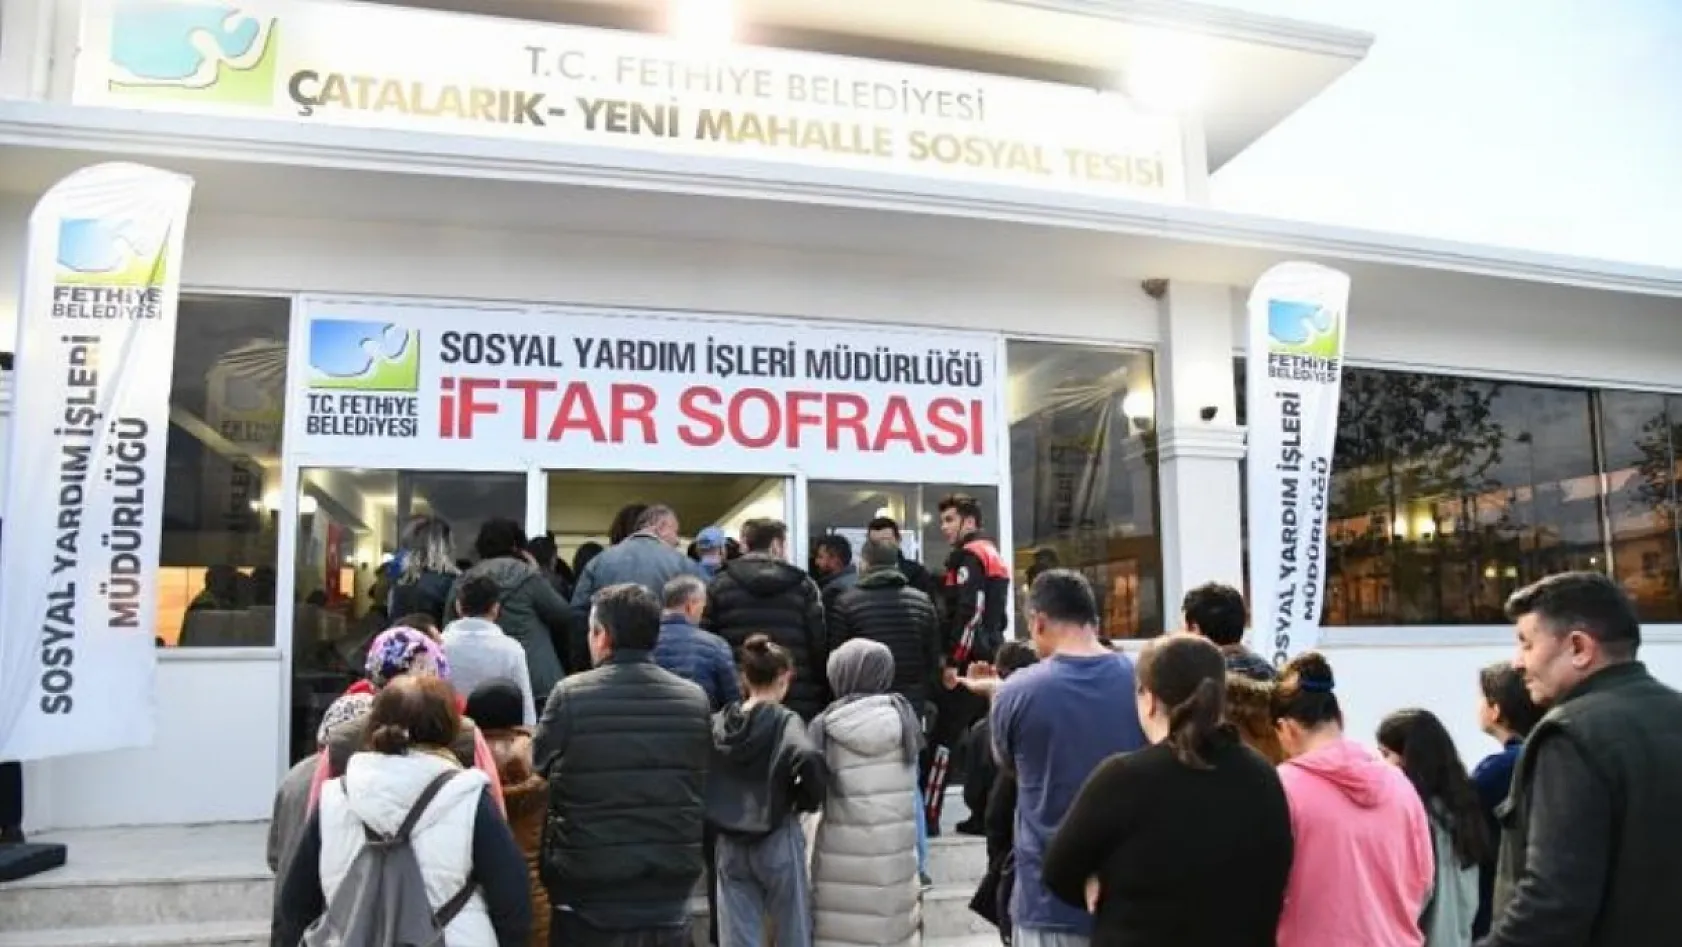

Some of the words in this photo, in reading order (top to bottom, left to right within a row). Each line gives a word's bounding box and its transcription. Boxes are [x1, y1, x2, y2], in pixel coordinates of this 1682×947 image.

[523, 44, 598, 81] T.C.
[787, 73, 986, 121] BELEDİYESİ
[575, 94, 681, 139] YENİ
[694, 107, 894, 158] MAHALLE
[907, 128, 1054, 176] SOSYAL
[440, 330, 562, 368] SOSYAL
[573, 337, 696, 374] YARDIM
[705, 336, 797, 378] İŞLERİ
[805, 343, 983, 388] MÜDÜRLÜĞÜ
[676, 384, 985, 456] SOFRASI
[1275, 391, 1305, 472] İŞLERİ
[52, 444, 92, 576] YARDIM
[99, 416, 149, 629] MÜDÜRLÜĞÜ
[1279, 478, 1299, 580] YARDIM
[40, 582, 76, 716] SOSYAL
[1272, 583, 1297, 667] OSYAL
